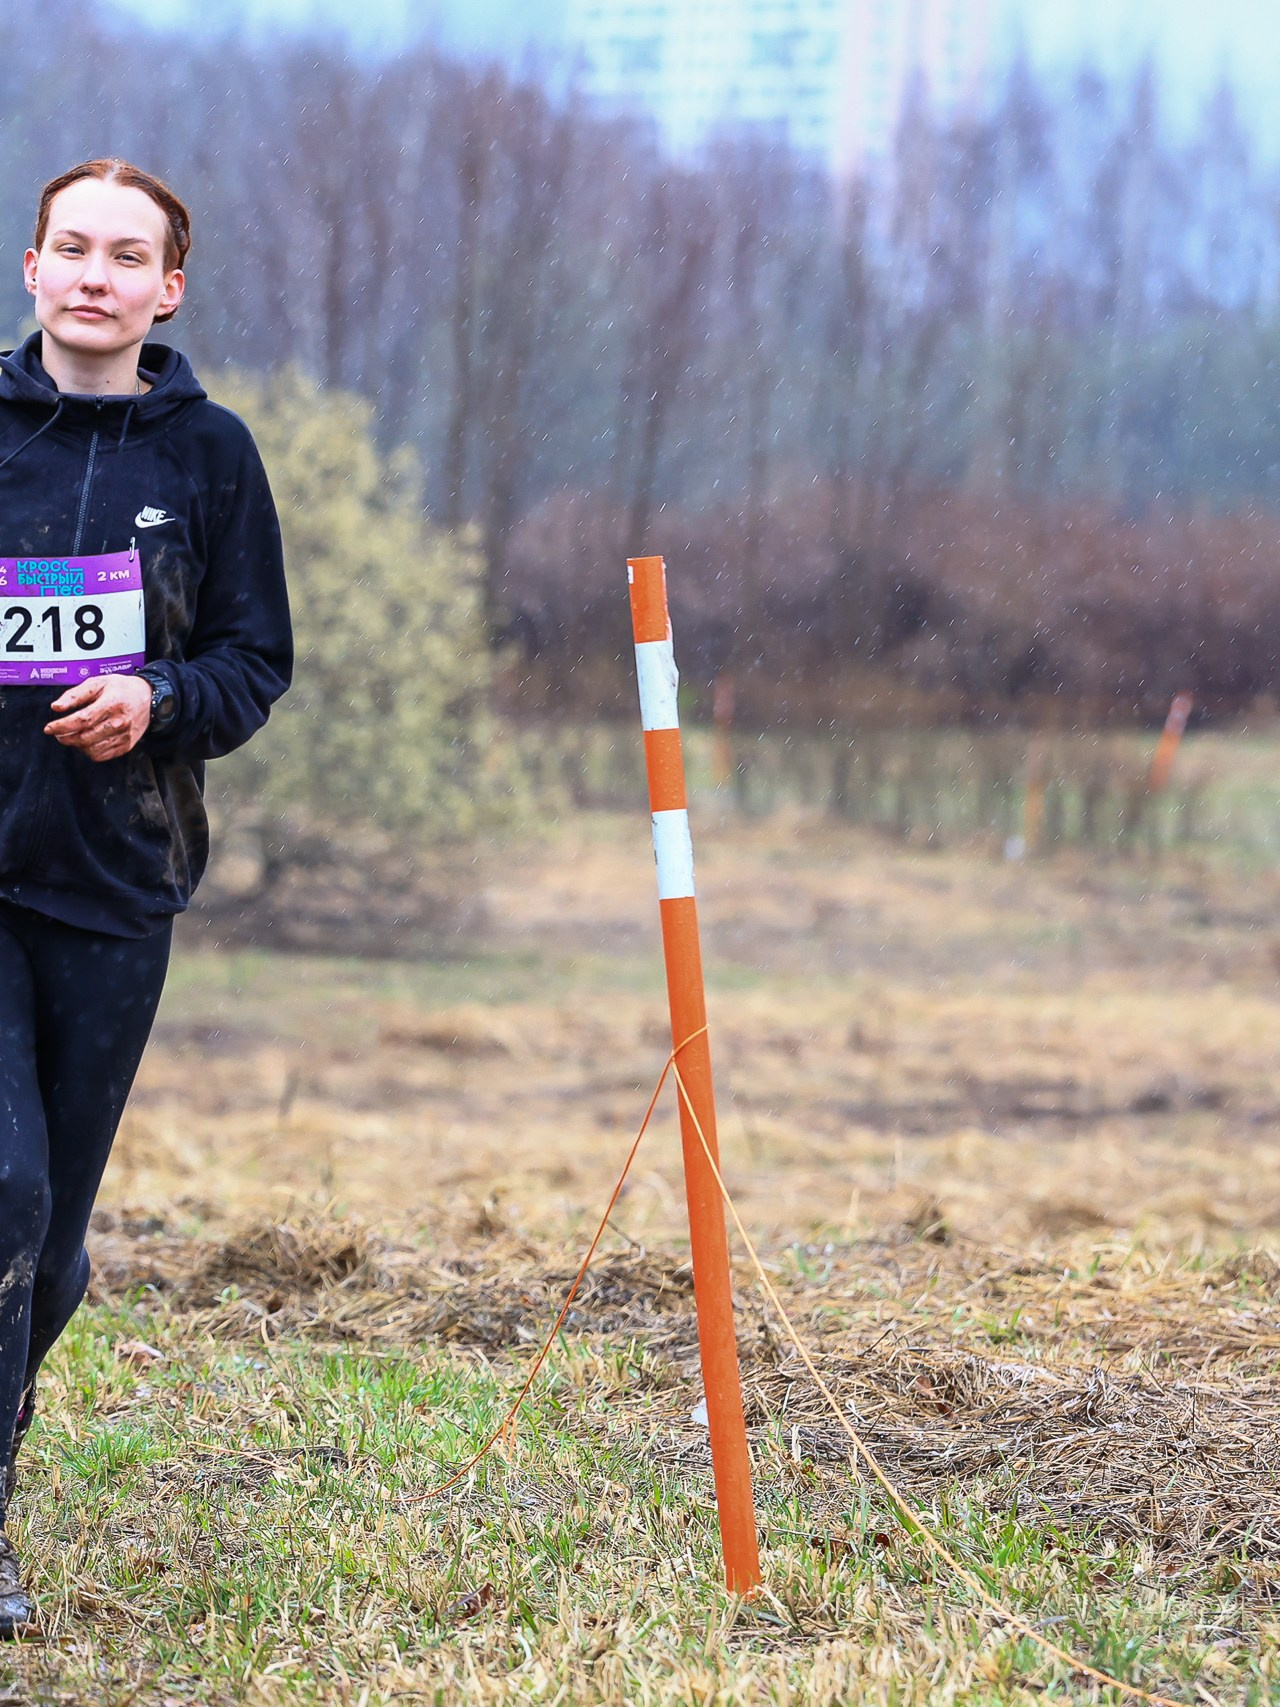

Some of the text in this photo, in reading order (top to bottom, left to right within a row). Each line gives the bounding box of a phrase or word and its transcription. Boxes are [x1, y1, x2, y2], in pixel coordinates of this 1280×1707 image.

[141, 505, 167, 522] NIKE
[17, 560, 70, 573] КРОСС
[18, 568, 84, 585] БЫСТРЫЙ
[97, 571, 107, 582] 2
[4, 604, 105, 653] 218
